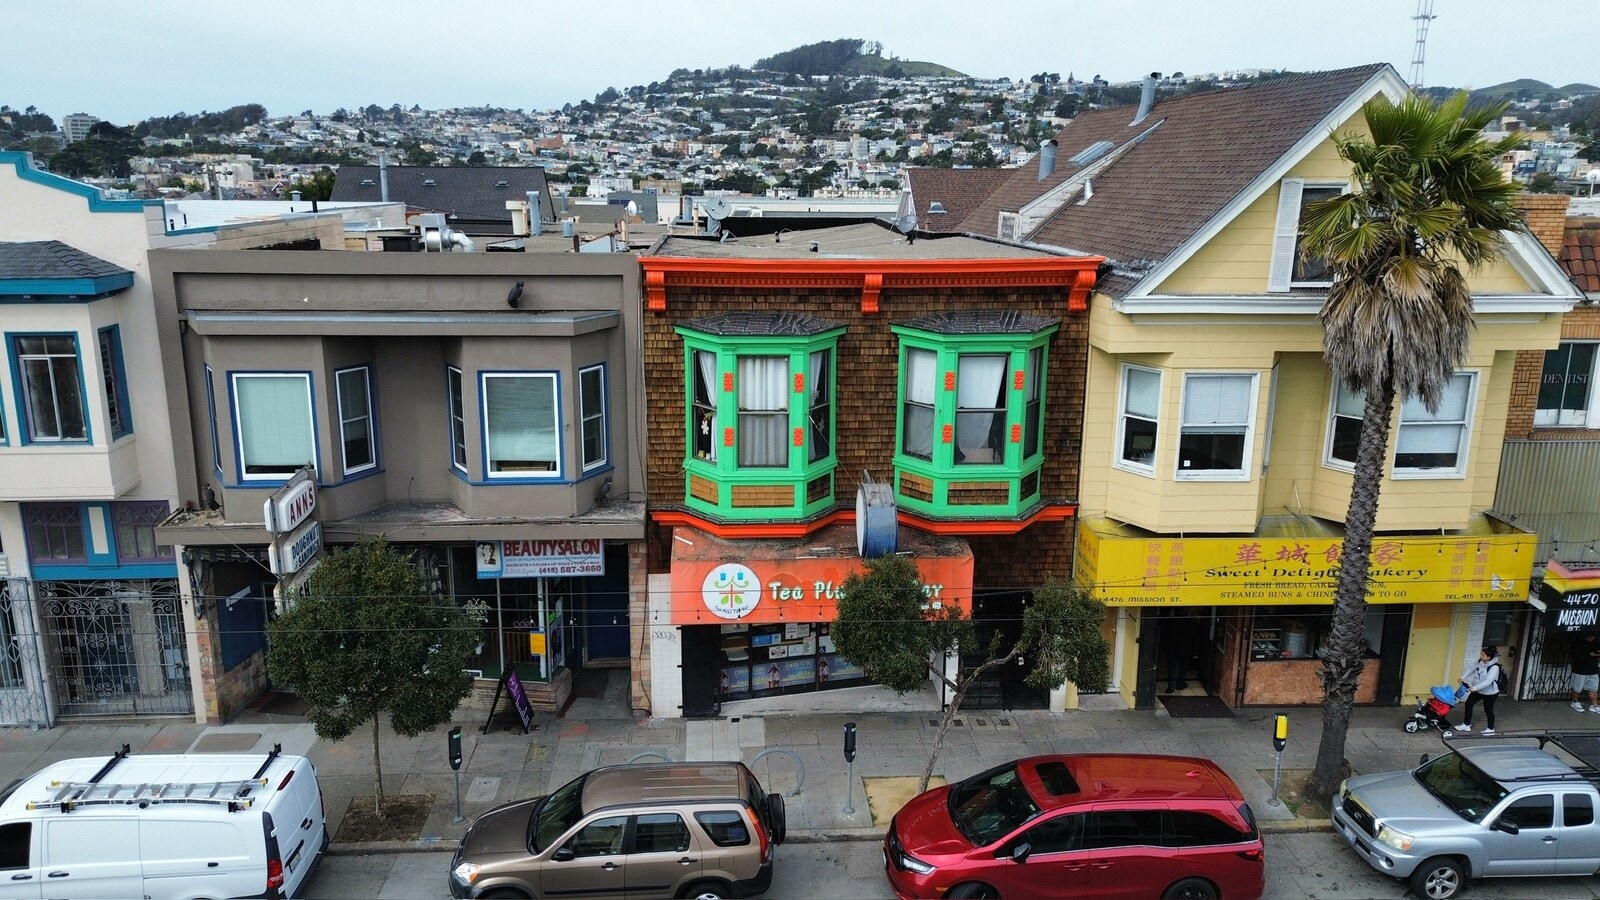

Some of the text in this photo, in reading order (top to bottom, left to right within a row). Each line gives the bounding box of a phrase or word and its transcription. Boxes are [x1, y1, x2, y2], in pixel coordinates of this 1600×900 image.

[1543, 373, 1589, 384] DENTIST
[290, 486, 314, 525] ANN'S
[539, 567, 558, 575] (415)
[1205, 567, 1428, 580] Sweet Deligh akery
[769, 581, 803, 600] Tea
[1557, 608, 1599, 627] MISSION
